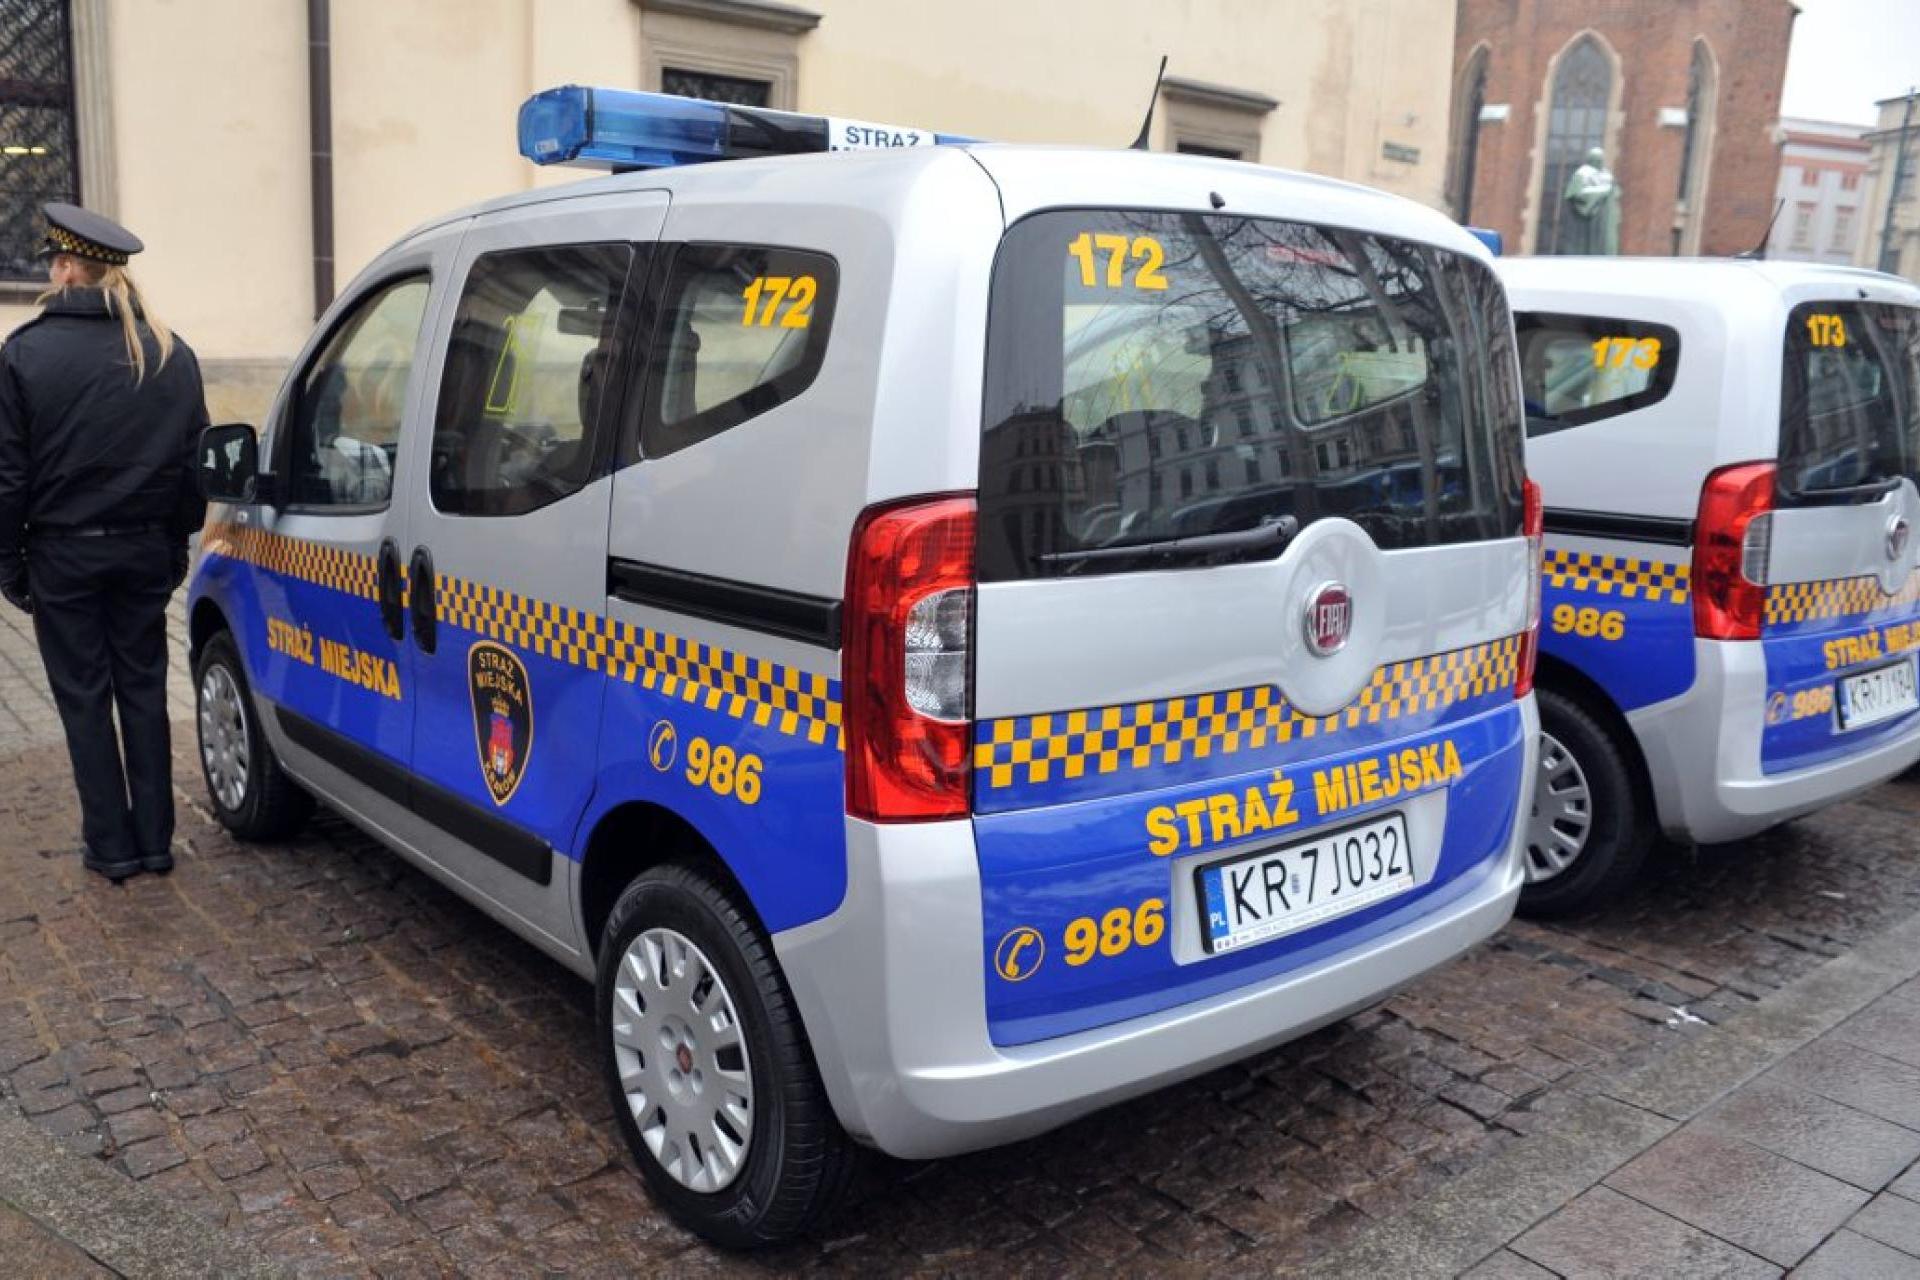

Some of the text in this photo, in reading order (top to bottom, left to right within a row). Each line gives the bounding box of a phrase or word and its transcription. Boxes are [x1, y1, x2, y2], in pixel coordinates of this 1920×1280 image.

[1068, 233, 1168, 290] 172
[742, 276, 817, 328] 172
[1592, 336, 1661, 369] 173
[1807, 314, 1846, 347] 173
[1319, 602, 1348, 637] FIAT
[1552, 603, 1625, 641] 986
[267, 620, 401, 700] STRAŻ MIEJSKA
[1823, 625, 1881, 670] STRAŻ
[1791, 685, 1834, 719] 986
[685, 736, 763, 805] 986
[1145, 740, 1463, 857] STRAŻ MIEJSKA
[1231, 859, 1291, 925] KR
[1300, 825, 1402, 904] 7J032
[1063, 898, 1165, 967] 986
[1210, 911, 1226, 929] PL
